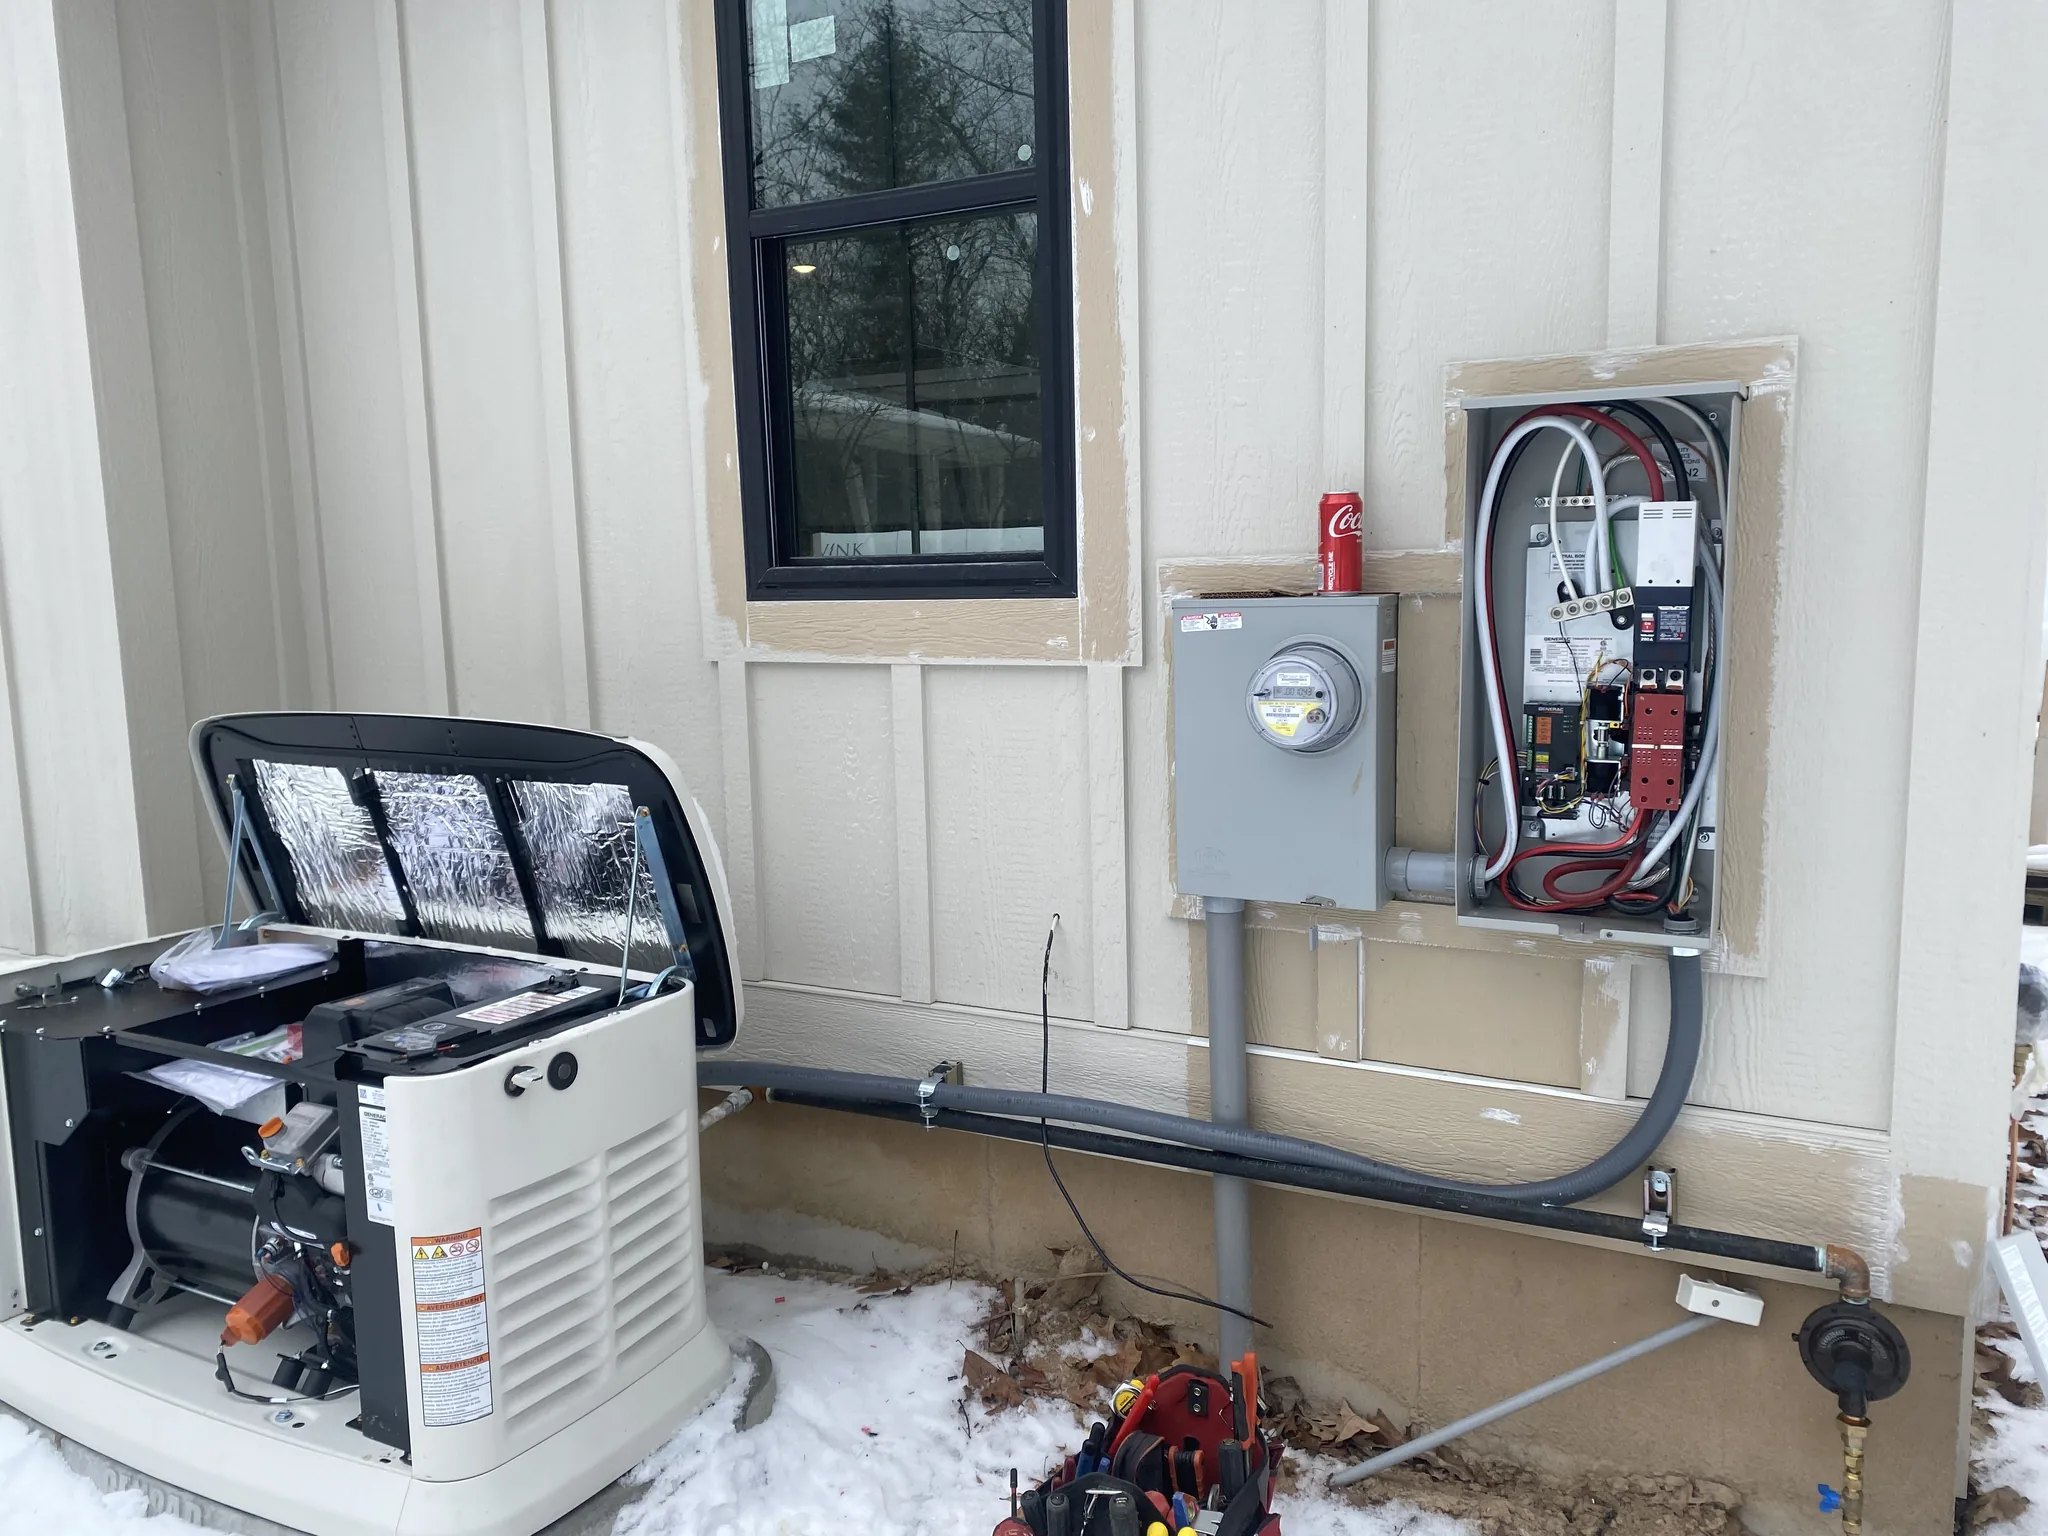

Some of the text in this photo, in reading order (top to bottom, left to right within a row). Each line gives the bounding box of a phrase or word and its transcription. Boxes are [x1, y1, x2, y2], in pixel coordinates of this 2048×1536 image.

[435, 1234, 468, 1243] WARNING
[427, 1296, 483, 1310] AVERTISSEMENT
[436, 1356, 484, 1371] ADVERTENCIA
